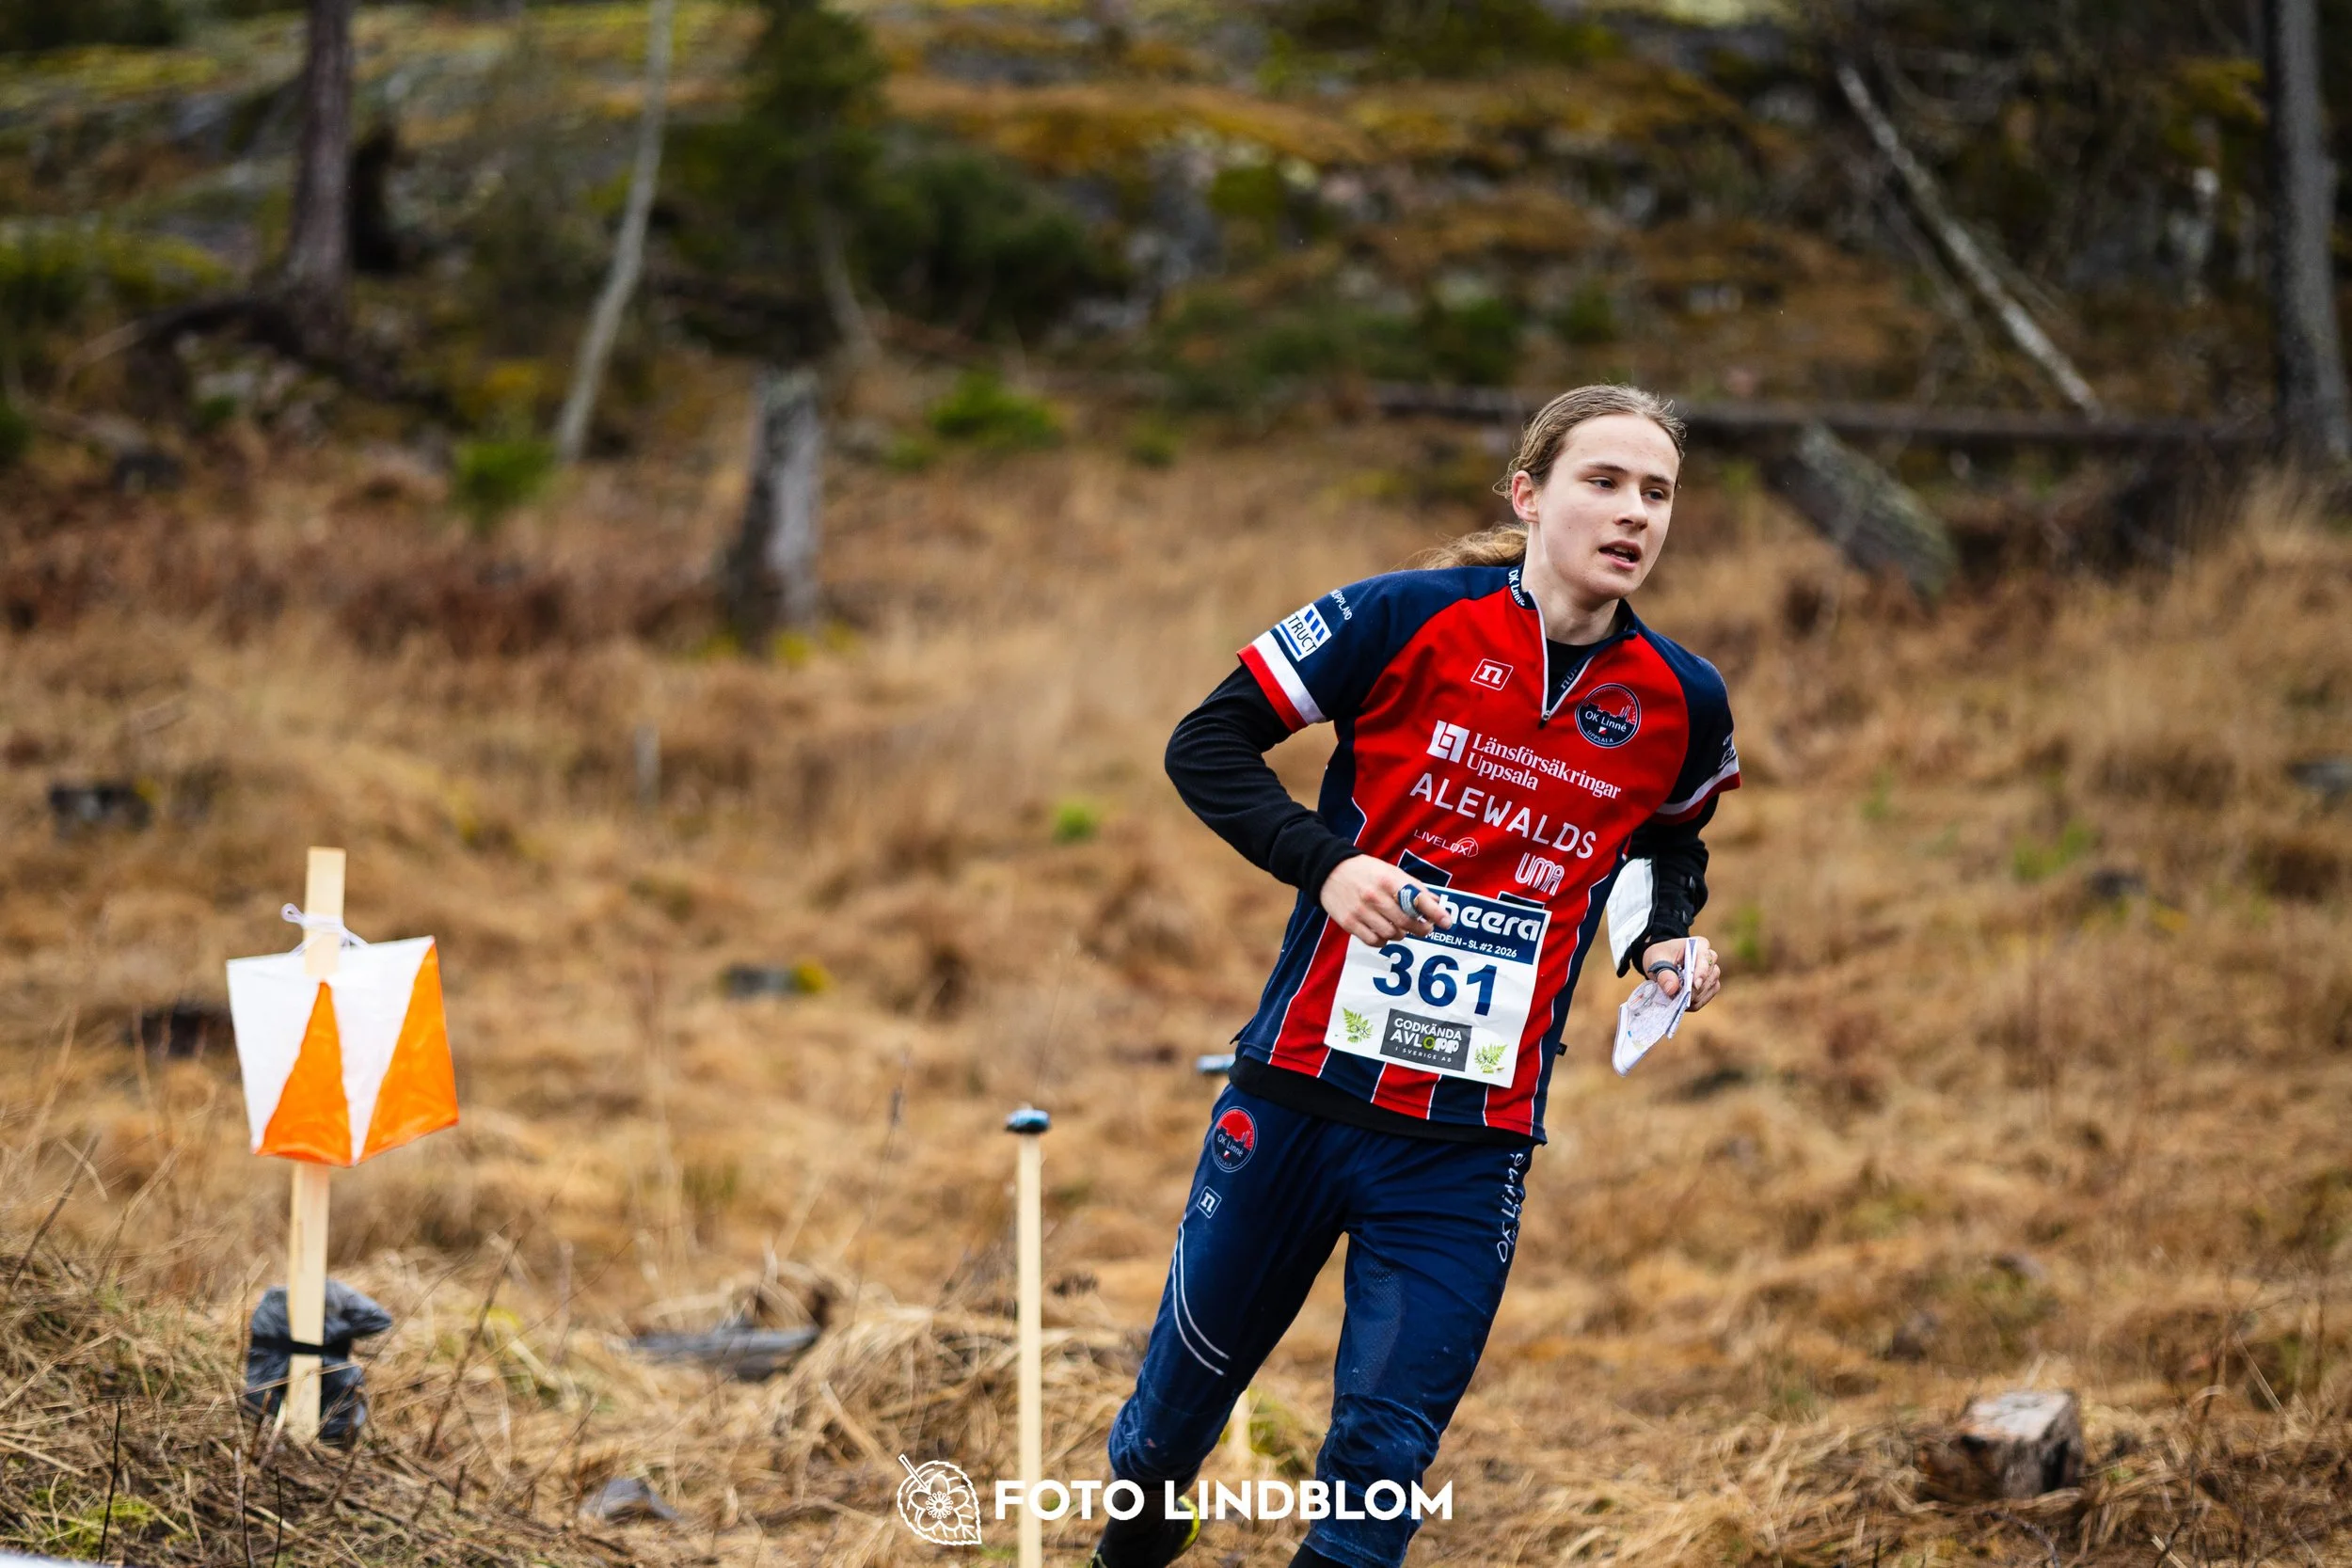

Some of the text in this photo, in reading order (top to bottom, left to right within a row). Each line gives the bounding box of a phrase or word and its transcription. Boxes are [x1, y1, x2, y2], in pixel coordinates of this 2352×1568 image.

[1508, 569, 1519, 584] OK
[1288, 615, 1317, 652] TRUCT
[1585, 711, 1627, 733] OK Linné
[1586, 730, 1614, 743] UPPSALA
[1467, 752, 1539, 791] Uppsala
[1472, 733, 1622, 800] Länsförsäkringar
[1409, 772, 1597, 859] ALEWALDS
[1515, 851, 1565, 896] UMA
[1469, 940, 1478, 950] SL
[1479, 942, 1493, 953] #2
[1496, 945, 1518, 958] 2026
[1373, 943, 1498, 1017] 361
[1393, 1018, 1462, 1040] GODKÄNDA
[1402, 1048, 1437, 1060] SVERIGE
[1217, 1133, 1227, 1146] OK
